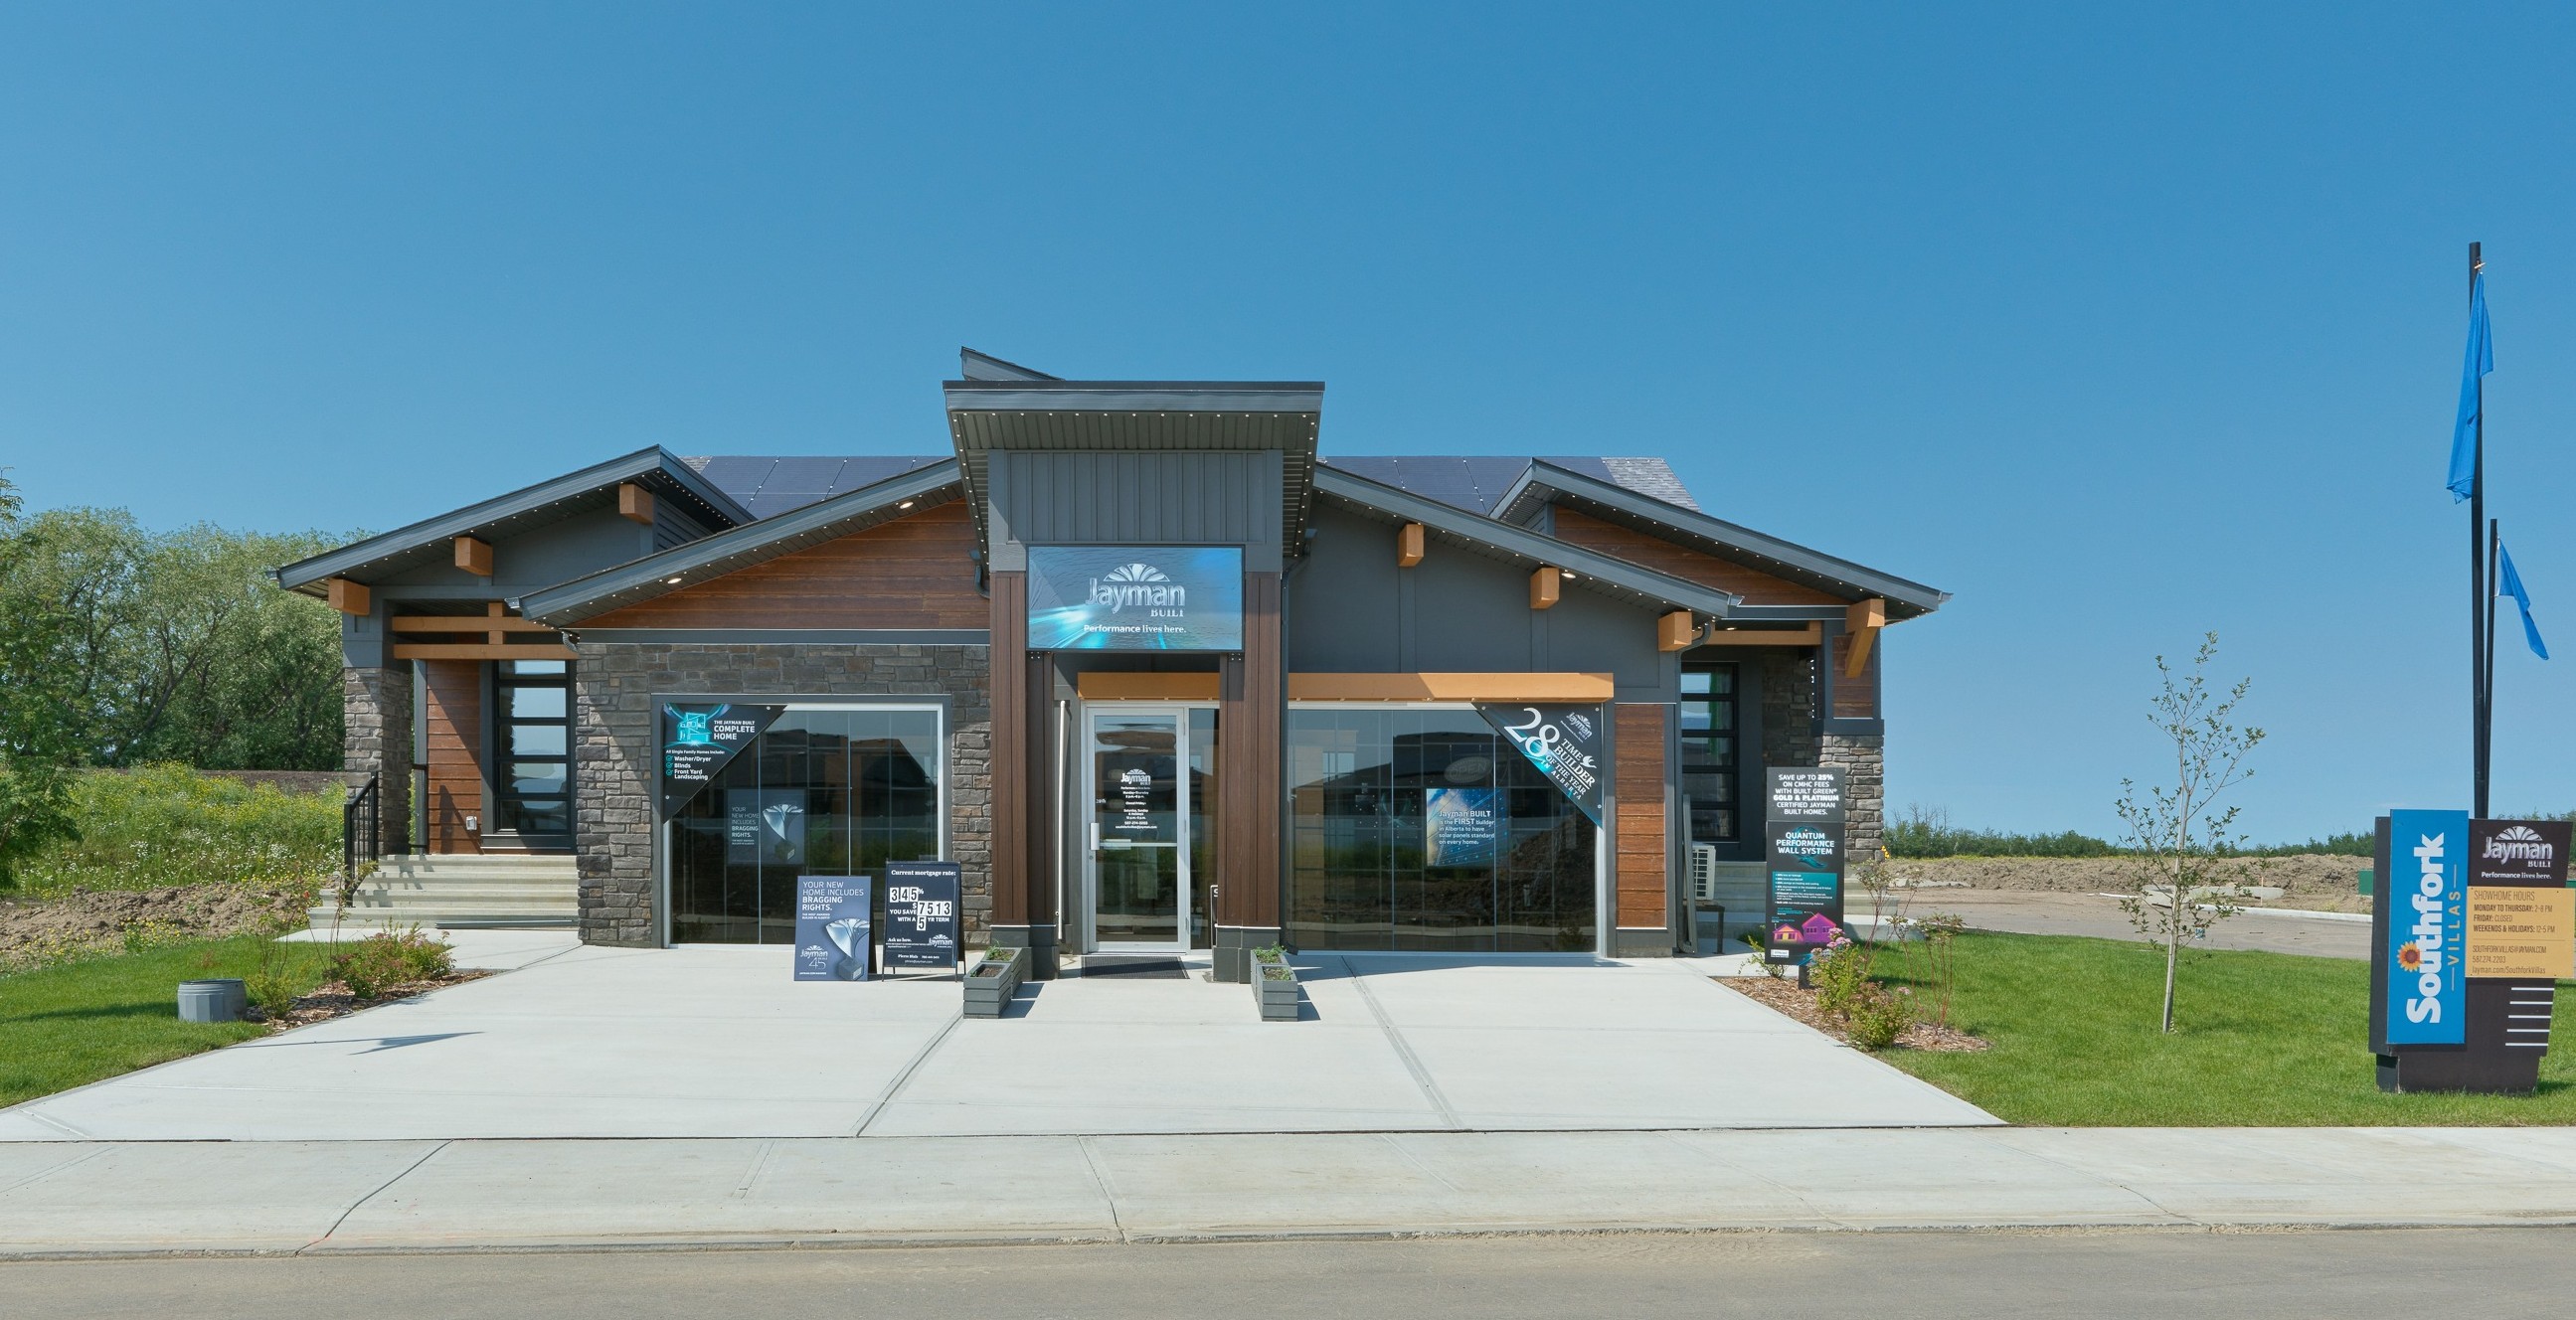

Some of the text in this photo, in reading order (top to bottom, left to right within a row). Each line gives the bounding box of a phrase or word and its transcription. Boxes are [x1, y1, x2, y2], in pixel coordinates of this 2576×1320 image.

[1085, 578, 1185, 614] Jayman
[1084, 624, 1140, 633] Performance
[1164, 624, 1187, 633] here.
[1504, 708, 1560, 757] 28
[1566, 712, 1592, 738] Jayman
[1562, 739, 1583, 760] TIME
[1450, 763, 1486, 778] OPEN
[1546, 755, 1586, 795] OF THE YEAR
[1554, 746, 1595, 787] BUILDER
[1121, 773, 1151, 784] Jayman
[1541, 760, 1581, 799] IN ALBERTA
[2483, 837, 2553, 865] Jayman
[2474, 891, 2535, 901] SHOWHOME HOURS
[918, 917, 924, 929] 5
[2406, 832, 2444, 1023] Southfork
[2448, 891, 2461, 966] VILLAS
[929, 938, 953, 947] Jayman
[801, 950, 828, 959] Jayman
[809, 957, 826, 969] 45
